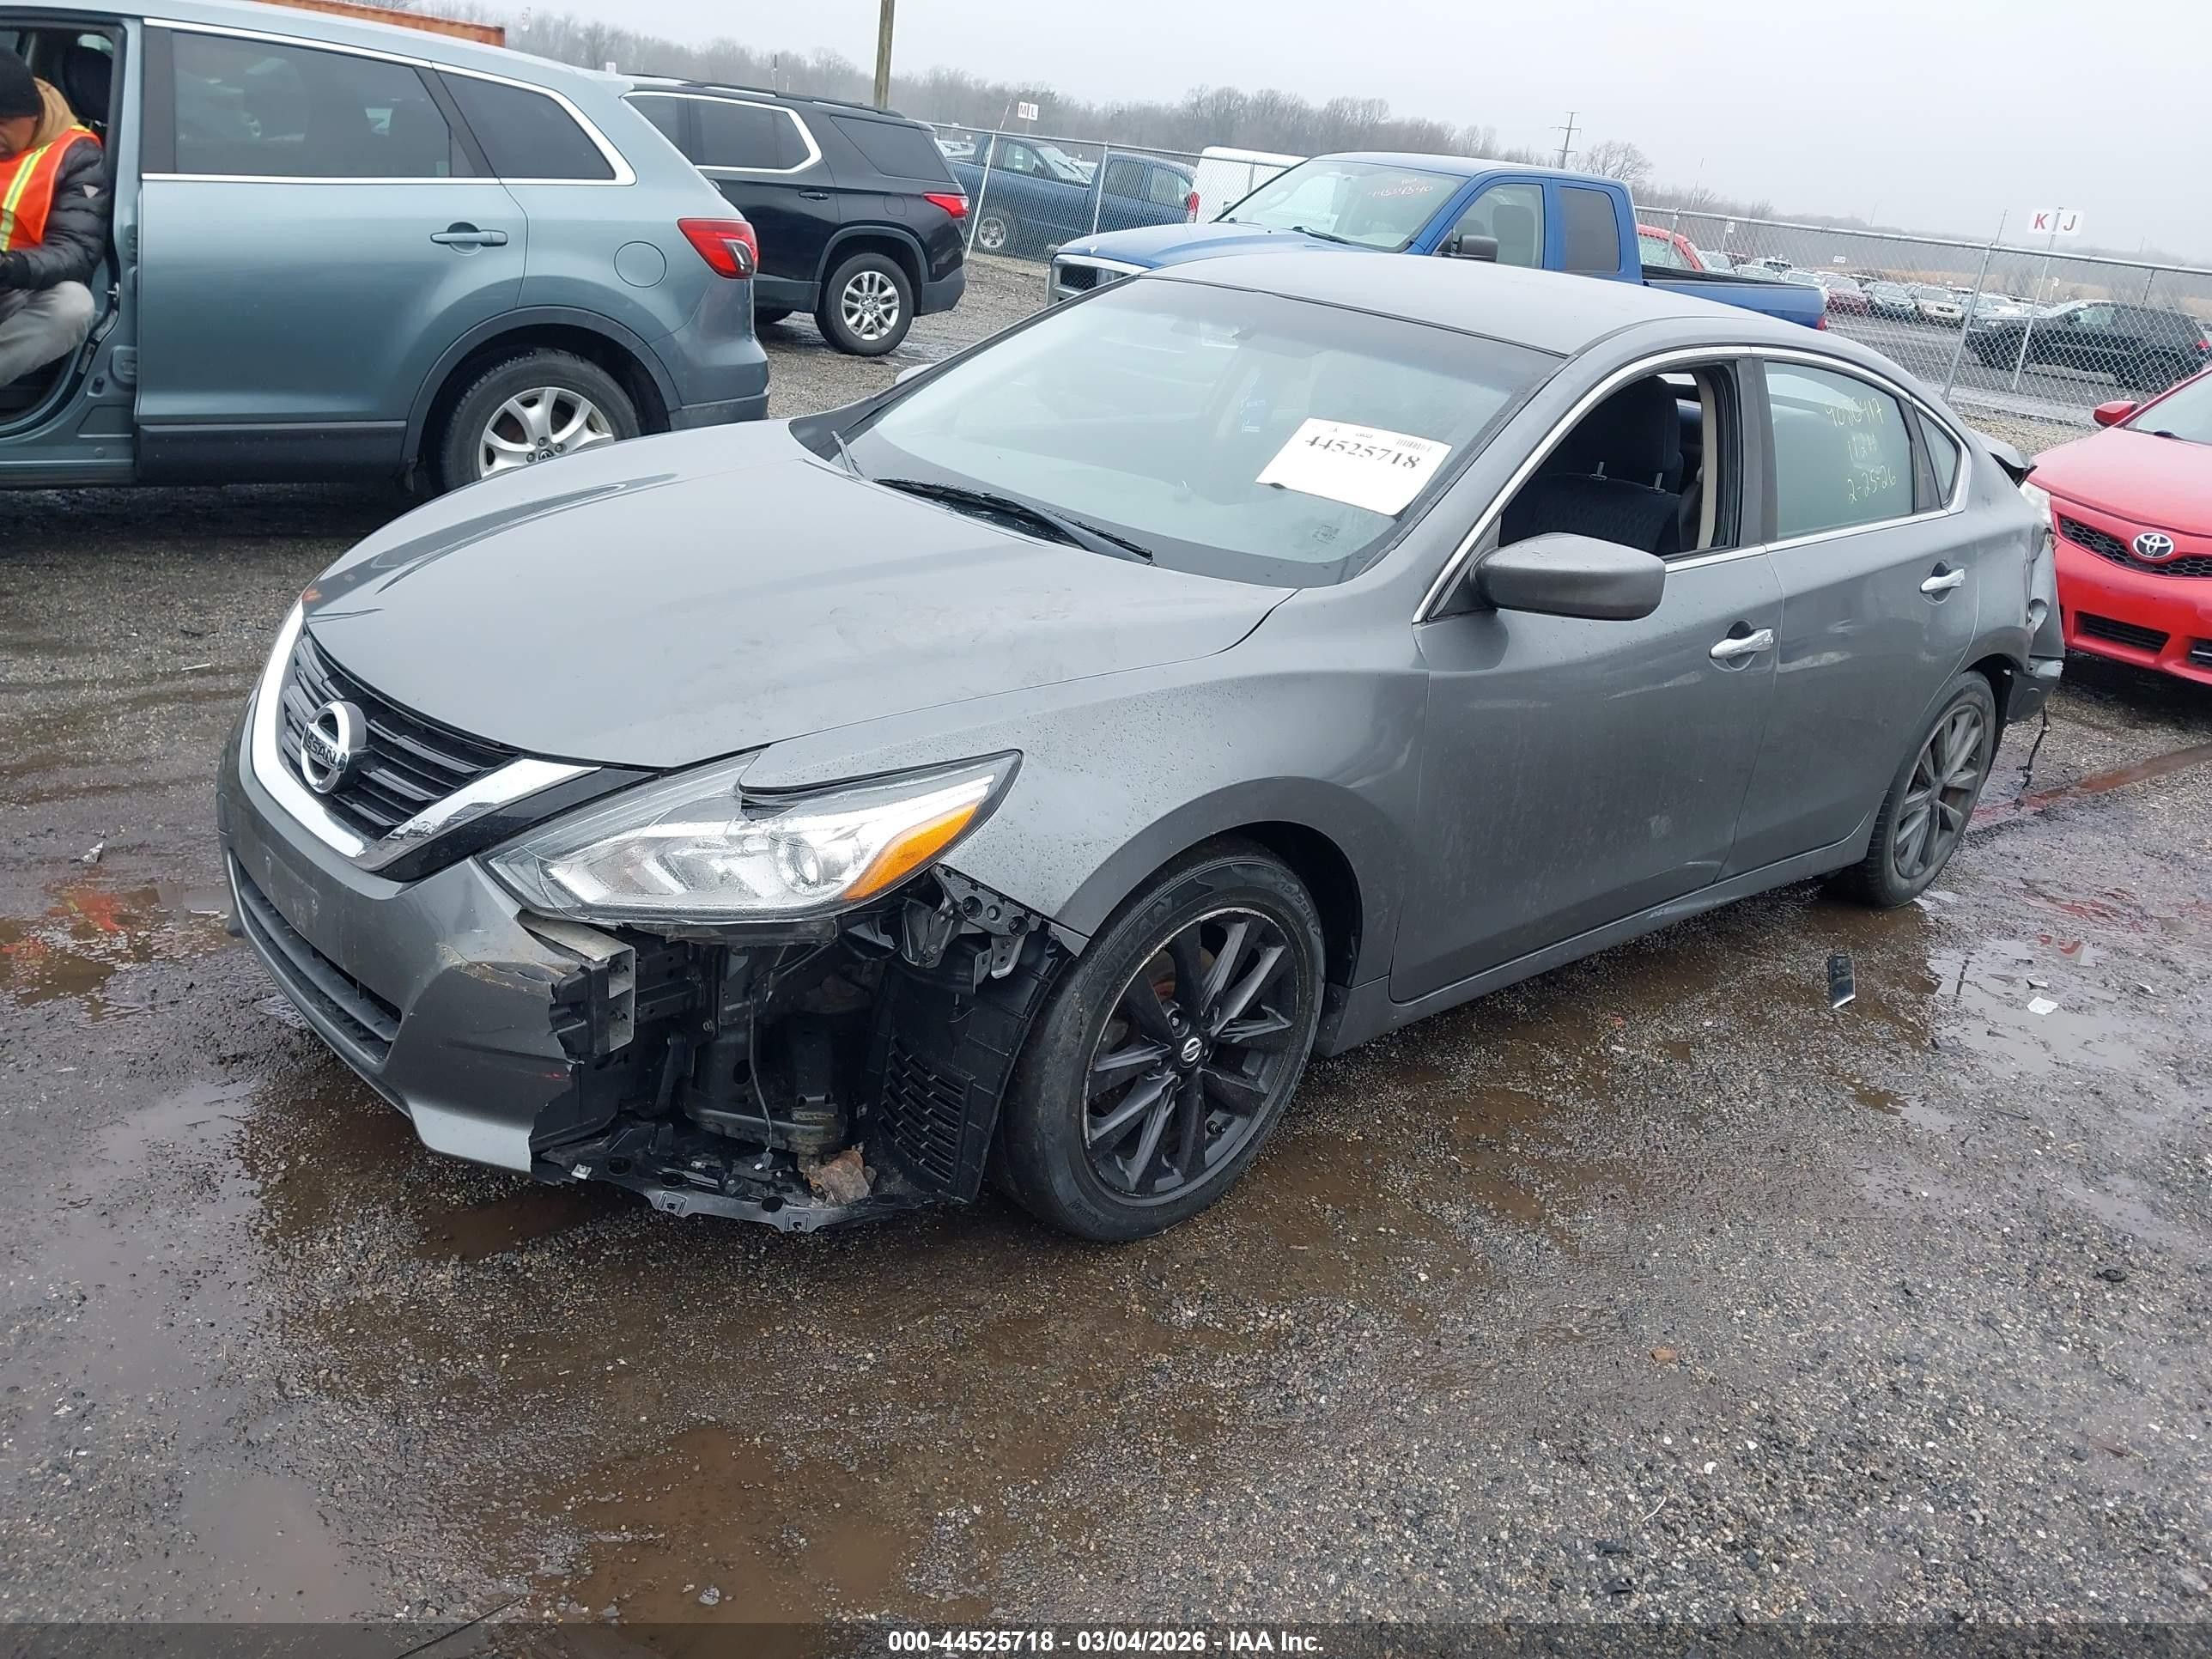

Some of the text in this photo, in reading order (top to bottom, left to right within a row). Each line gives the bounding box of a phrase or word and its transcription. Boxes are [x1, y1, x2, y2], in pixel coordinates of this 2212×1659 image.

[2033, 213, 2076, 231] K J
[1304, 435, 1421, 470] 44525718
[1847, 465, 1896, 504] 2-25-26
